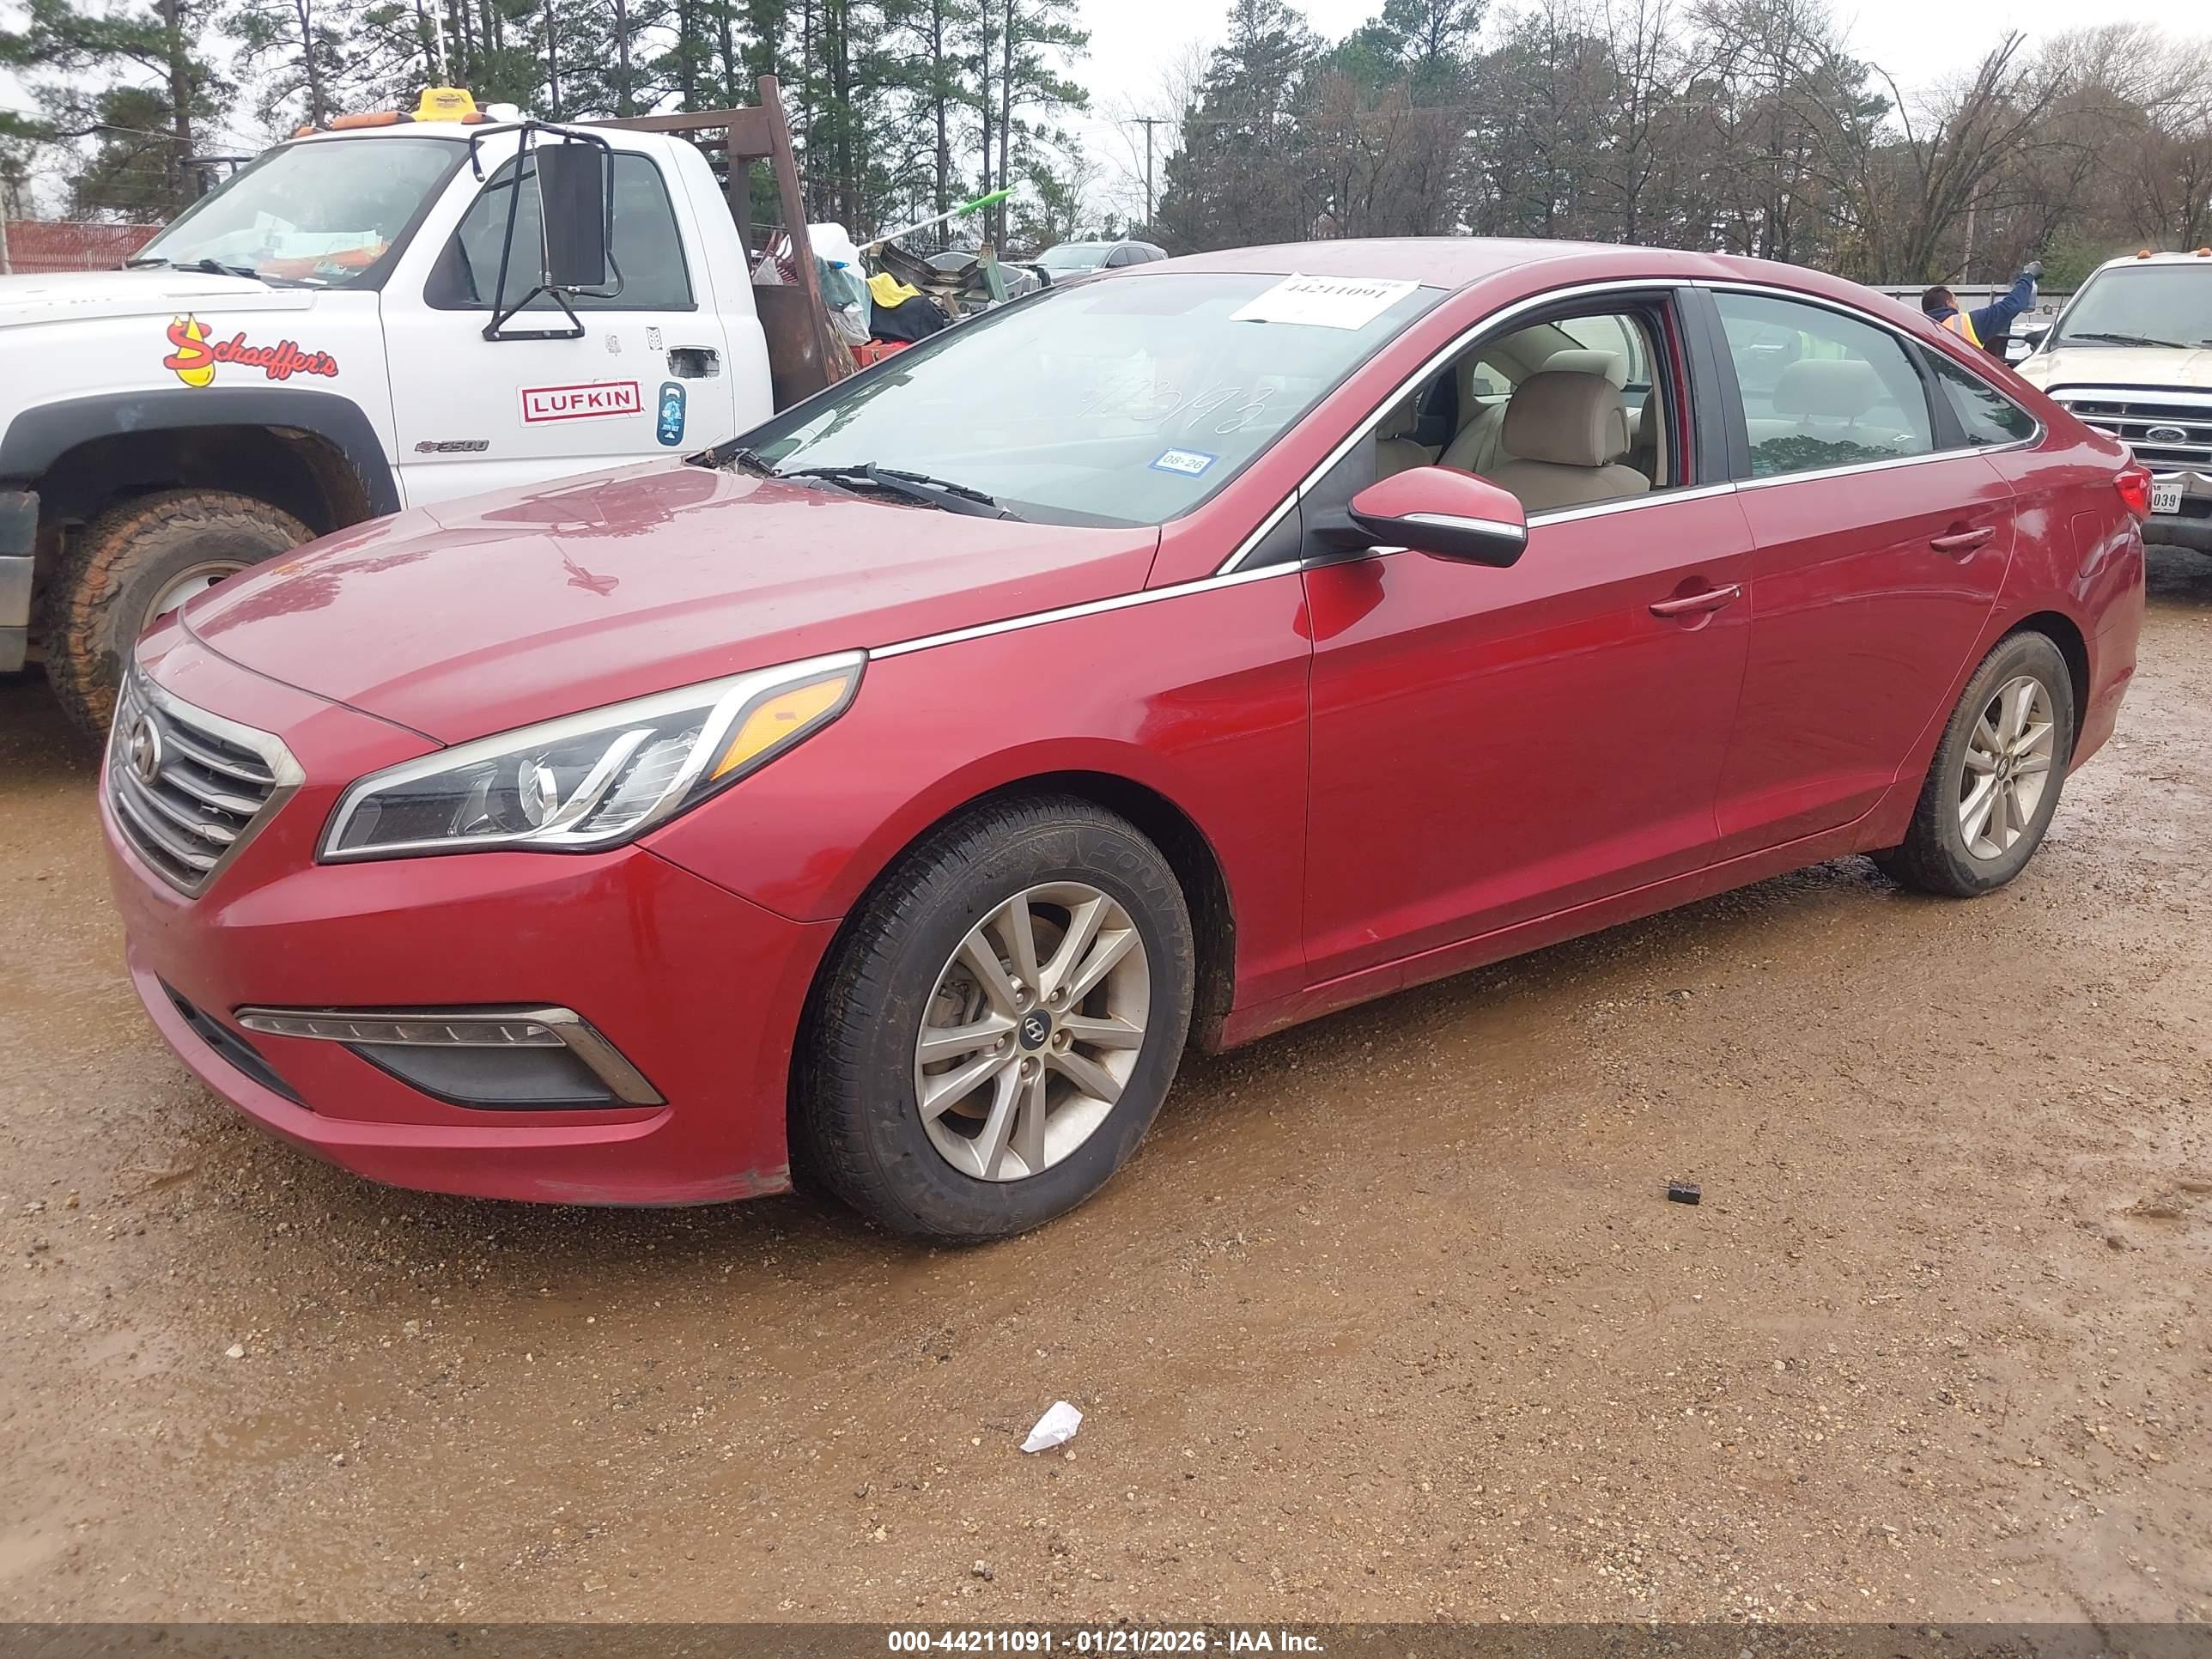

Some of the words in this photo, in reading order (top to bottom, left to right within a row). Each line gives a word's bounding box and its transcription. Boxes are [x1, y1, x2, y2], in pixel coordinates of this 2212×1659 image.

[1285, 284, 1388, 299] 44211091
[163, 321, 339, 380] Schaeffer's
[533, 391, 631, 413] LUFKIN
[439, 440, 489, 453] 3500
[2154, 493, 2177, 507] 039
